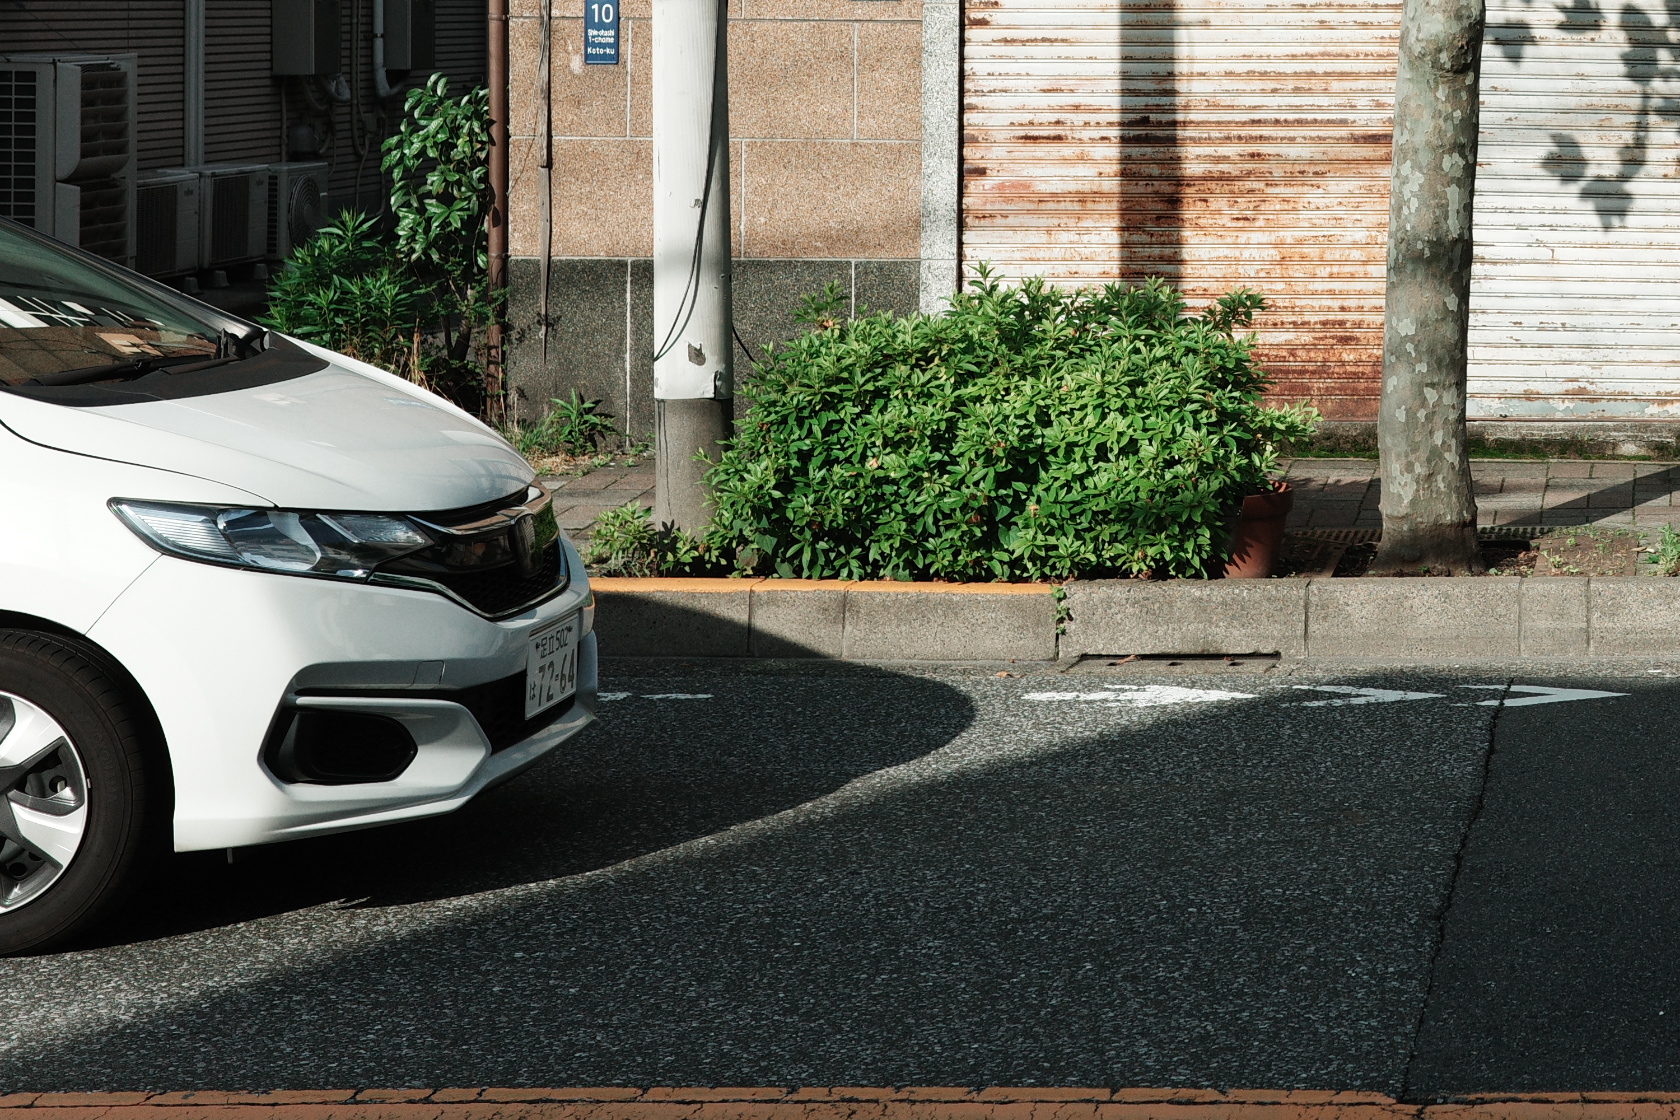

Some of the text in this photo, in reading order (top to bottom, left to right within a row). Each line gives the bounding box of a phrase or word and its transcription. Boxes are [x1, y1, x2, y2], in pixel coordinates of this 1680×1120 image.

[591, 3, 614, 23] 10
[540, 633, 554, 659] 足立
[538, 648, 575, 707] 72-64
